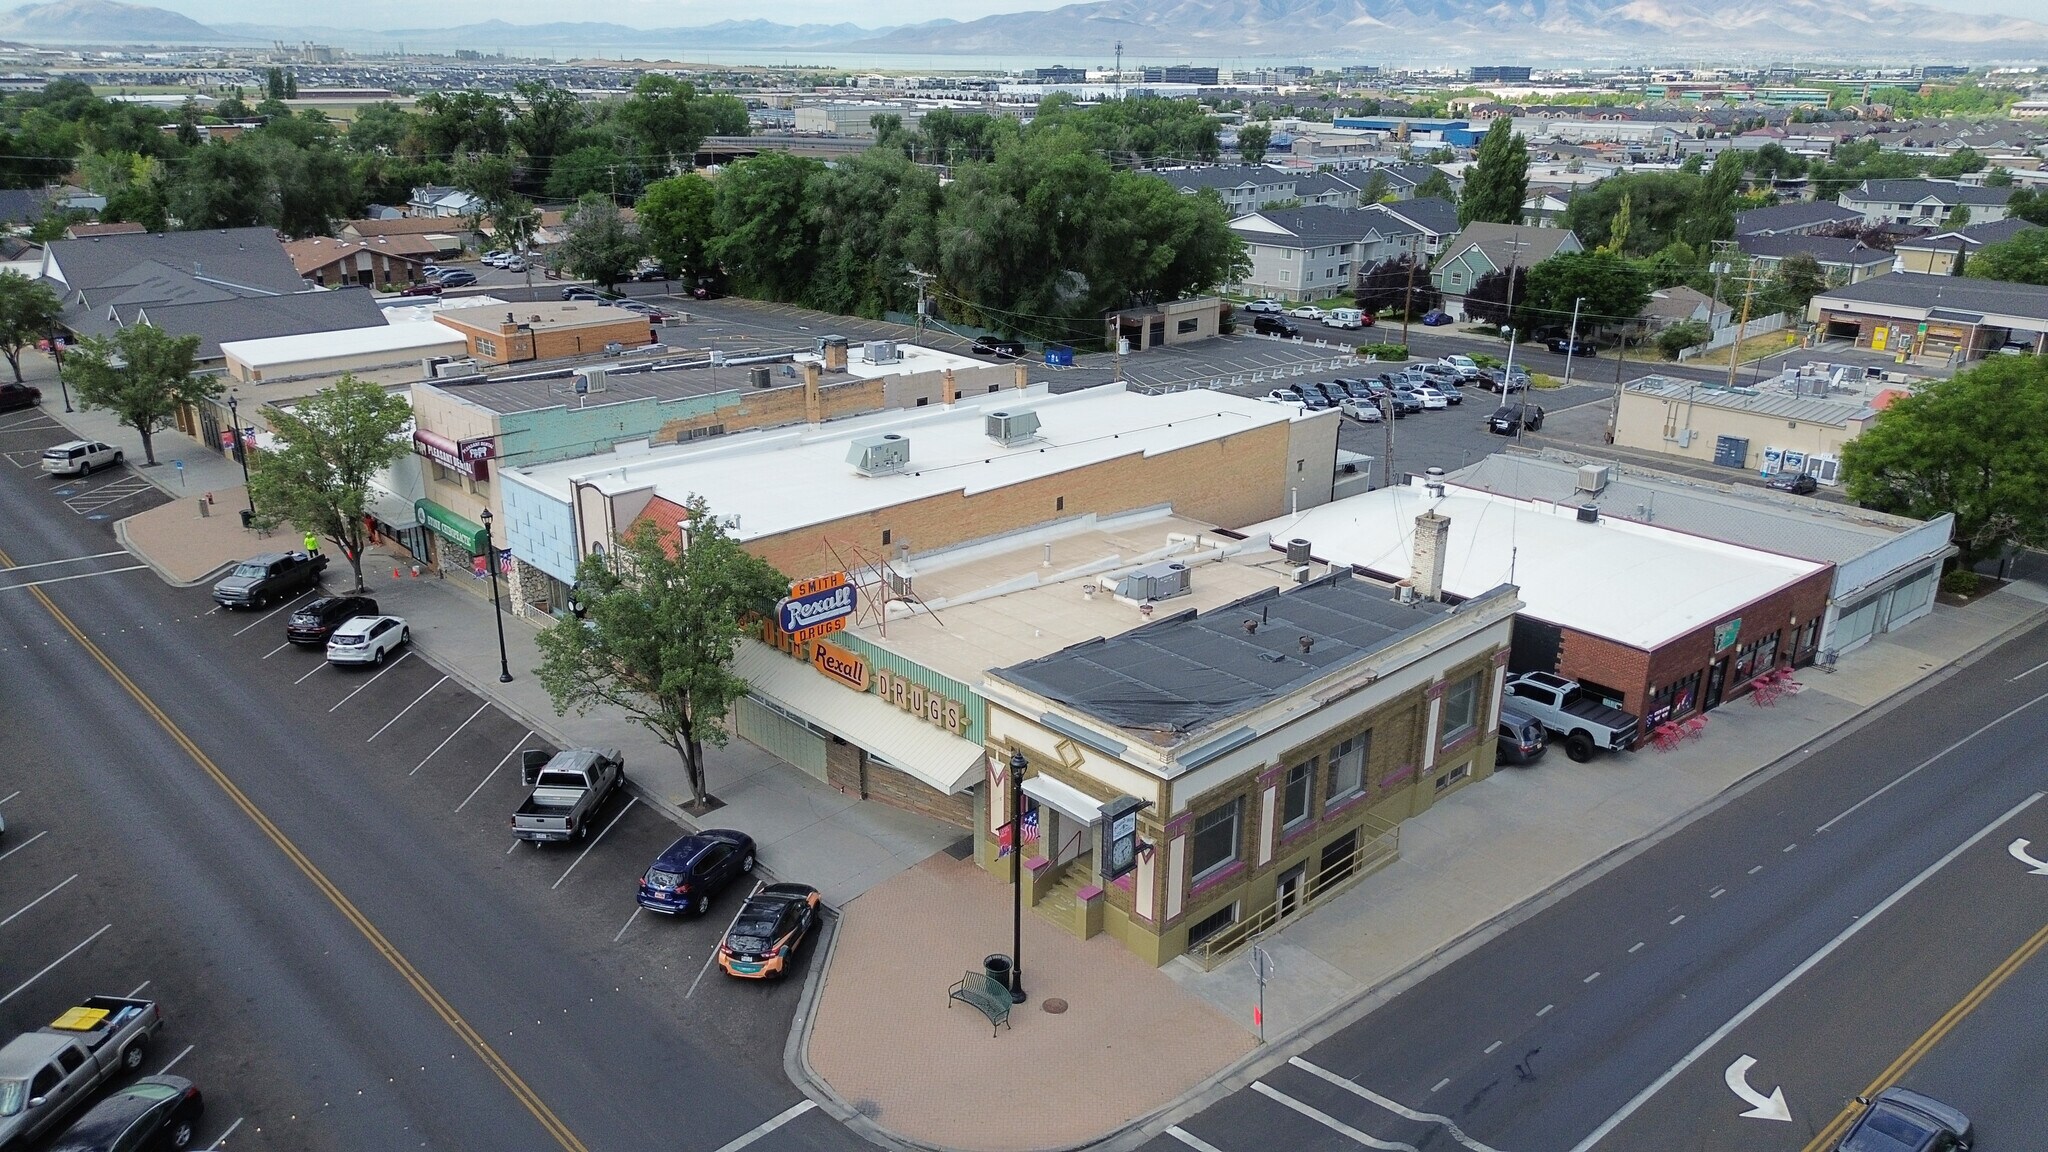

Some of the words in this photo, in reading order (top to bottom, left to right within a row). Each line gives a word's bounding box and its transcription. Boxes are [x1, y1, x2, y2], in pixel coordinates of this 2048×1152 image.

[426, 444, 453, 465] PLEASANT
[799, 575, 837, 596] SMITH
[786, 586, 852, 630] Rexall
[800, 619, 841, 642] DRUGS
[814, 643, 863, 686] Rexall
[879, 675, 957, 729] DRUGS
